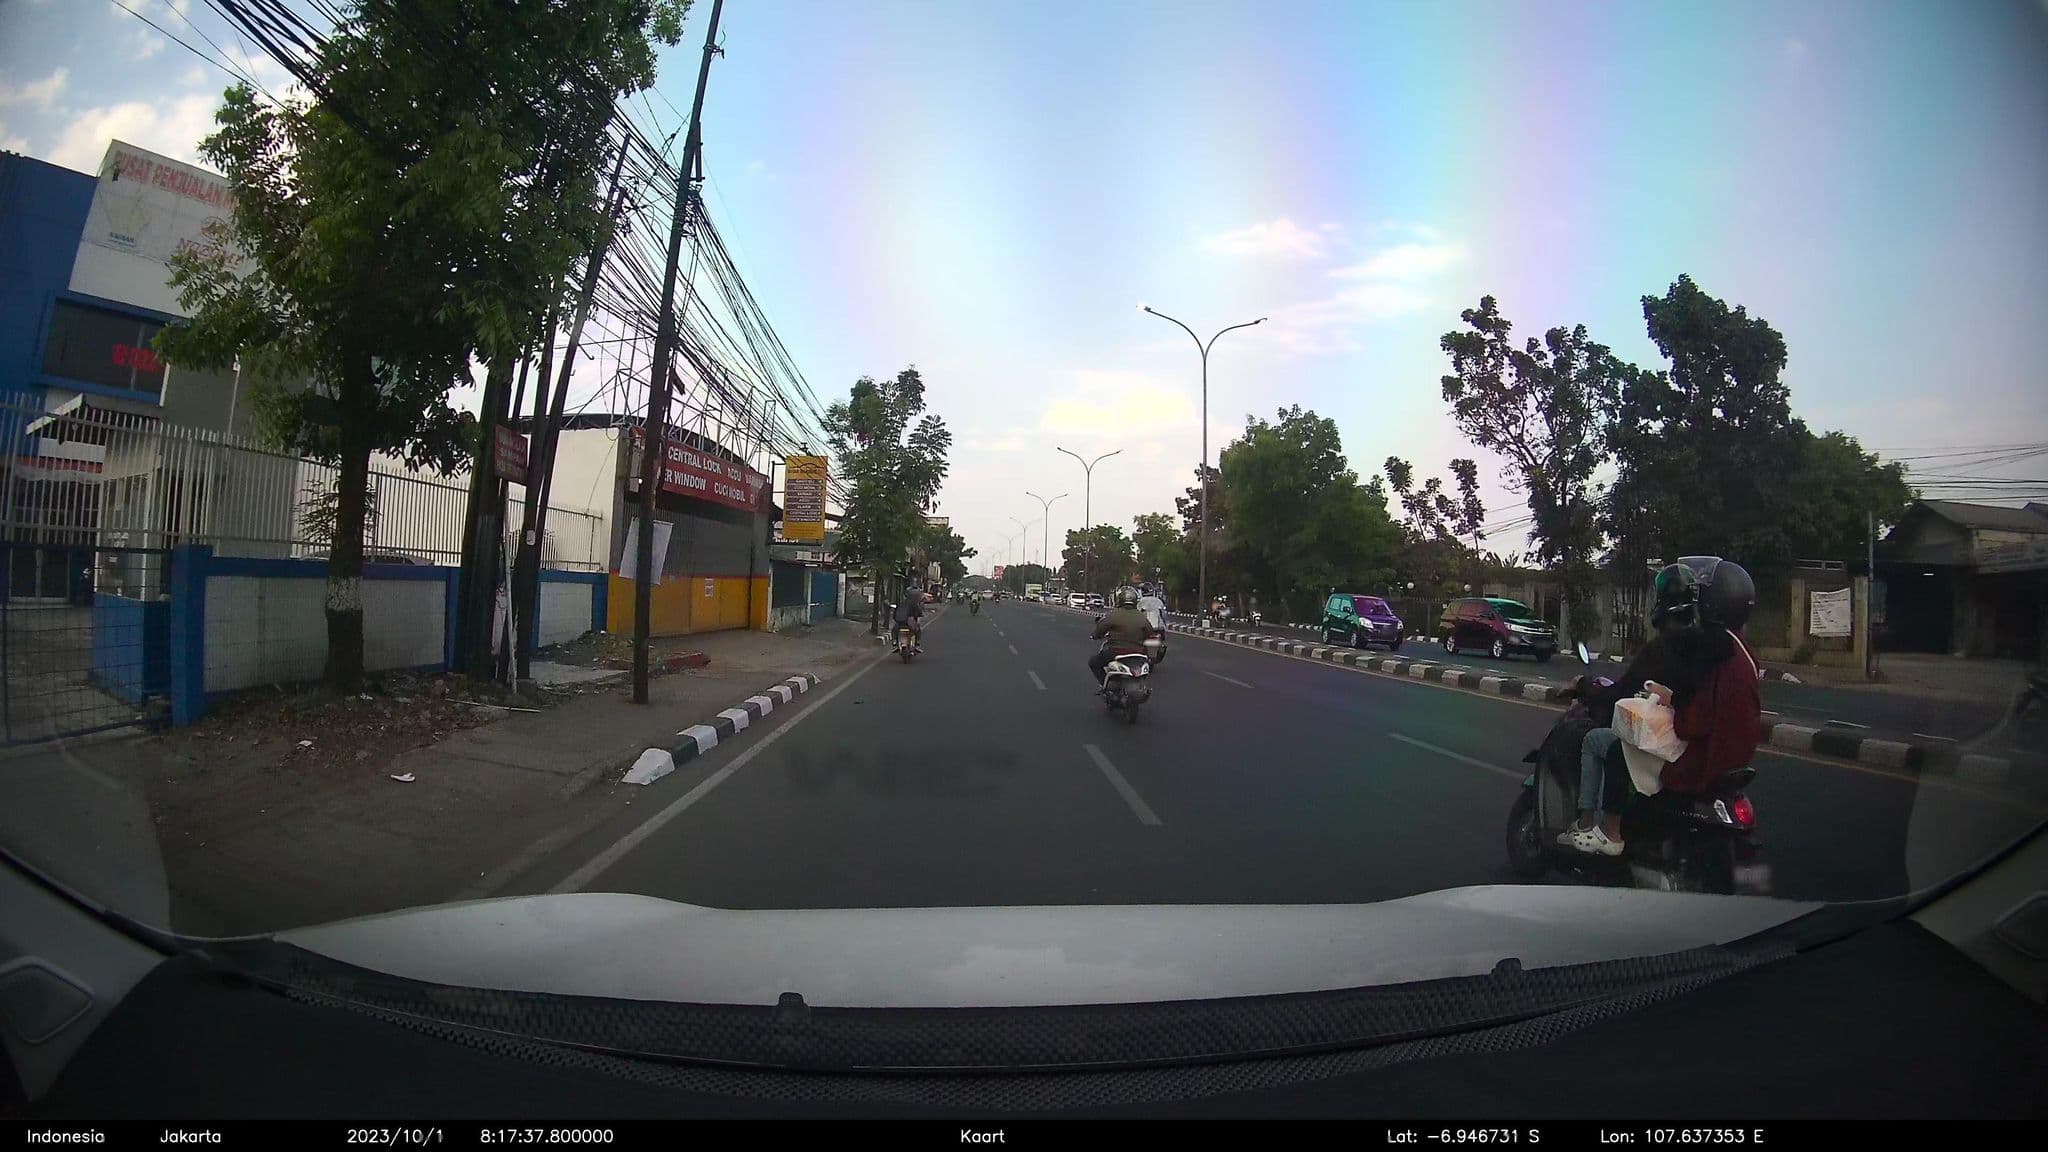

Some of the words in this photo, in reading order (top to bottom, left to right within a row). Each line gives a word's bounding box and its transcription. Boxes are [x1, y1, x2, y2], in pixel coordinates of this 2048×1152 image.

[668, 446, 702, 469] CENTRAL
[703, 459, 722, 475] LOCK
[674, 470, 707, 491] WINDOW
[714, 482, 729, 497] CUCI
